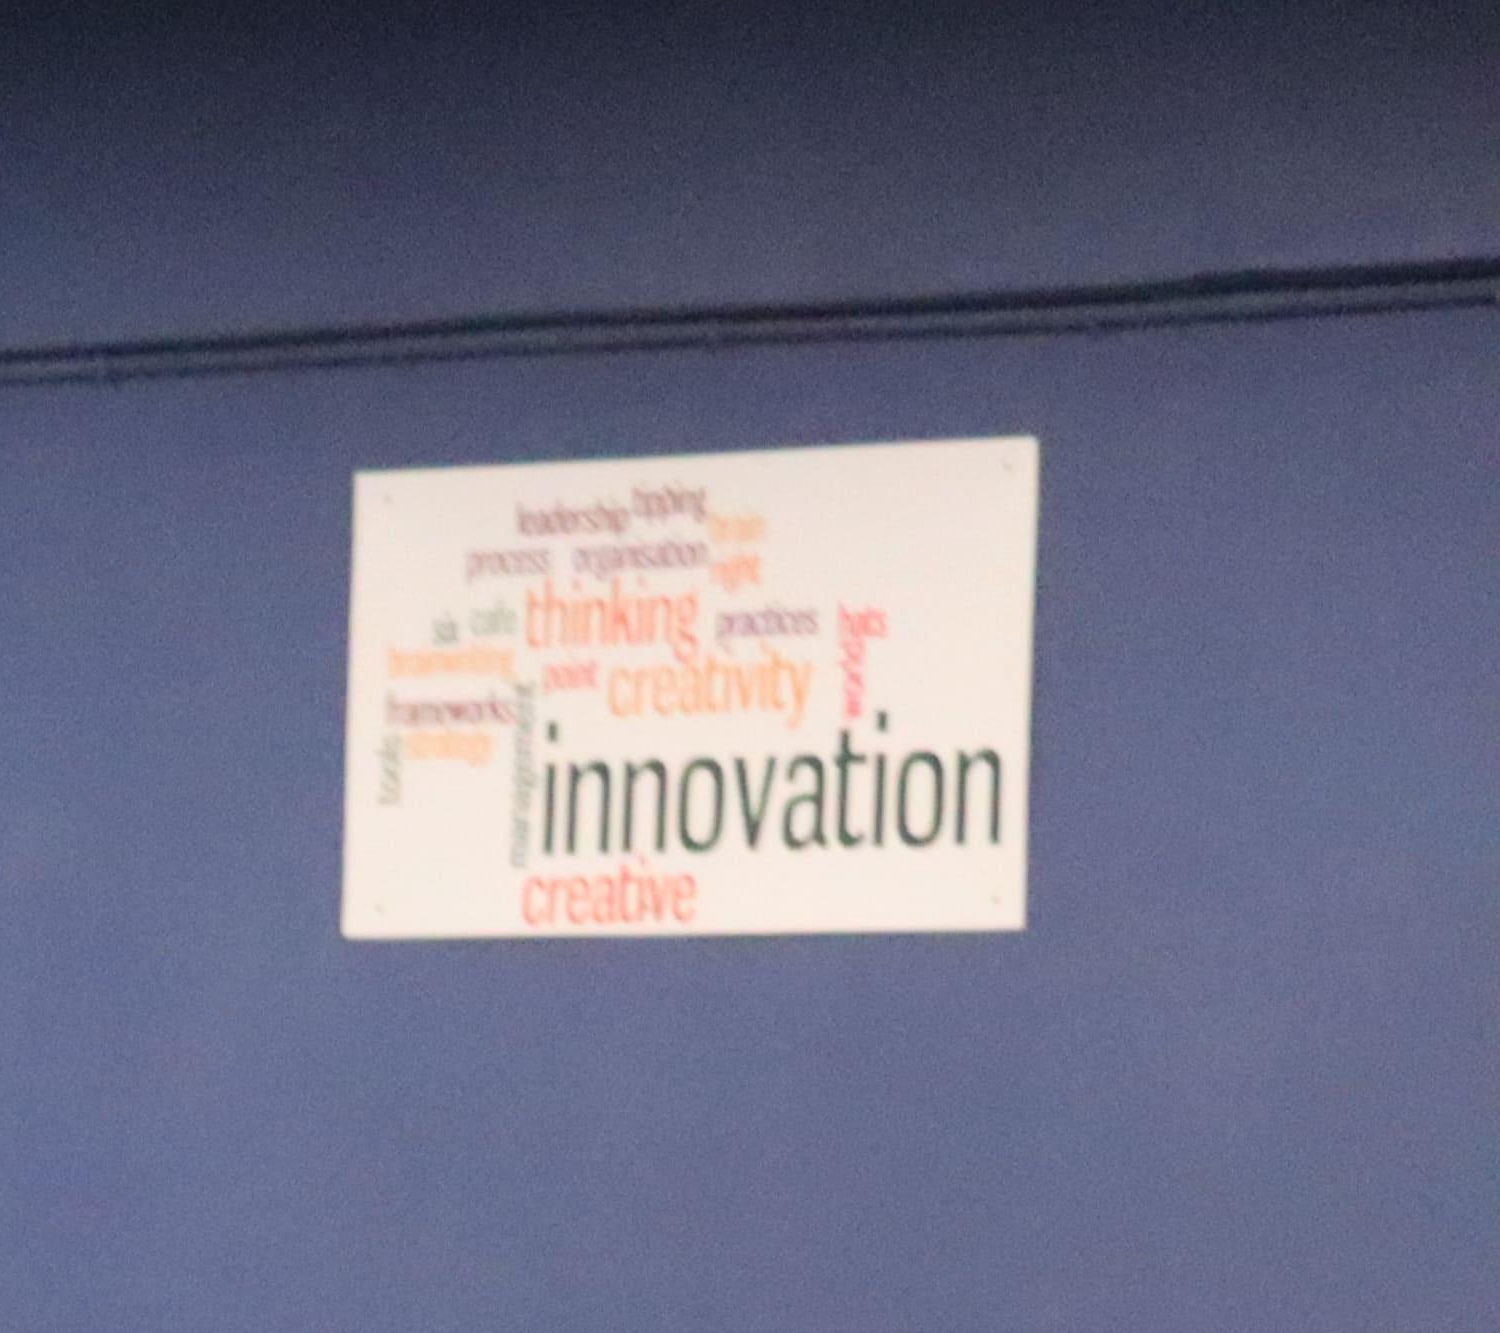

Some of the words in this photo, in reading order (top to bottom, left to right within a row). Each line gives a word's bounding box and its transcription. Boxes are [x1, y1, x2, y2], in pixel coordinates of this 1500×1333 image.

[524, 574, 698, 666] thinking
[607, 648, 814, 730] creativity
[543, 707, 1001, 854] innovation
[522, 852, 699, 926] creative
